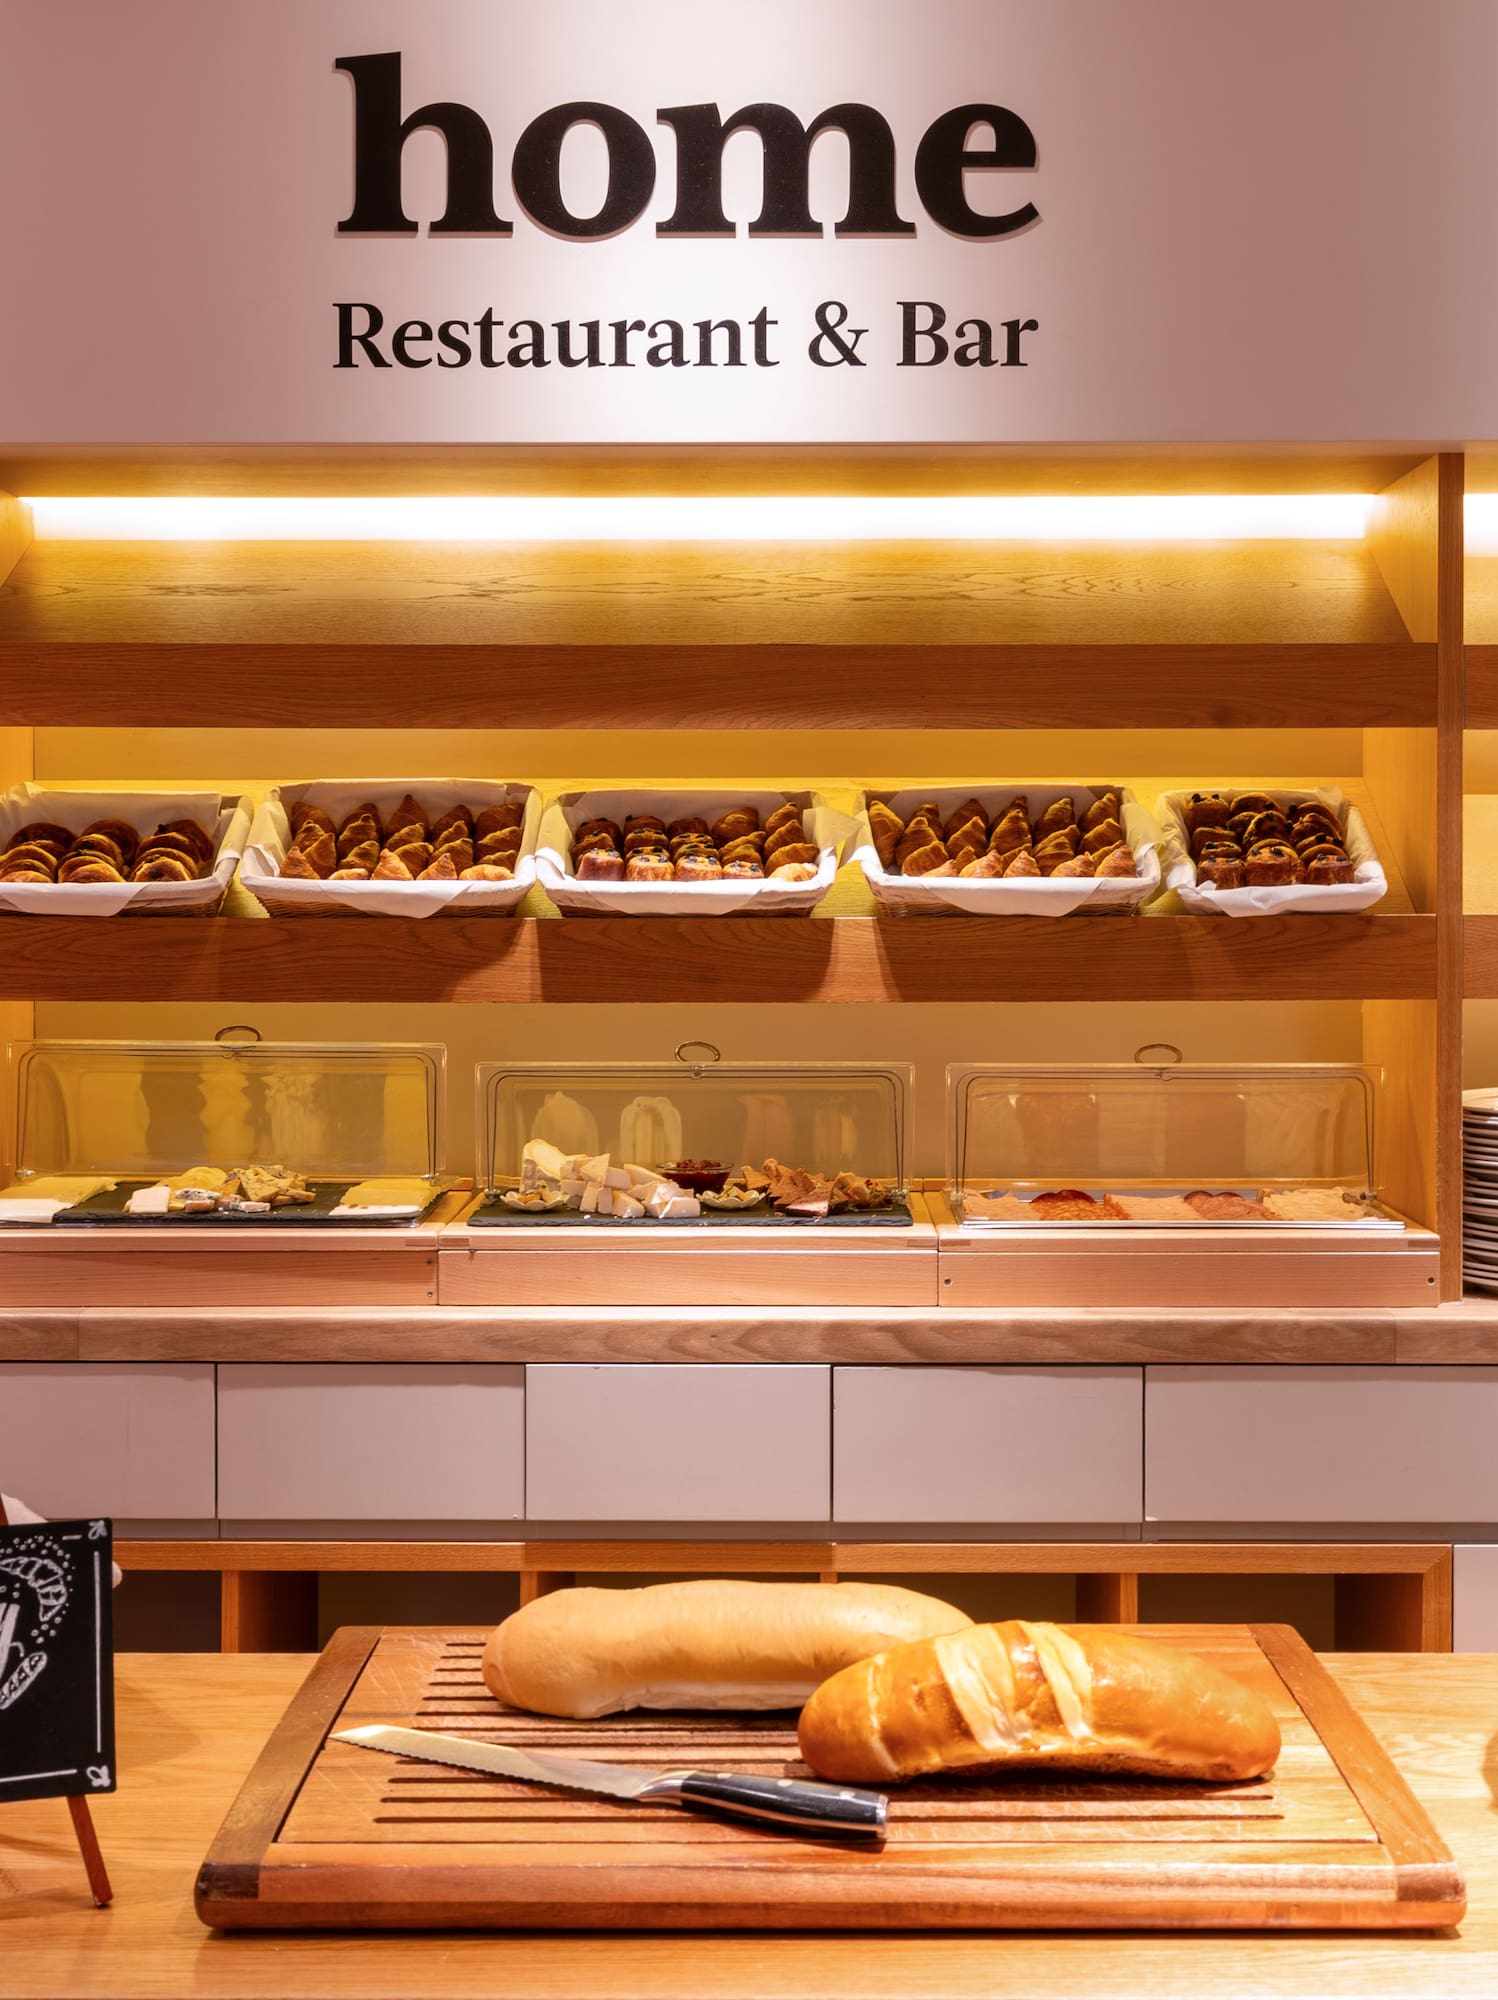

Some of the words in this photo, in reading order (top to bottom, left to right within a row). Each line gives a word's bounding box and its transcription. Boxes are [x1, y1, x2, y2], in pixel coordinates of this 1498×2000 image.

[334, 51, 1041, 238] home
[332, 302, 780, 369] Restaurant
[808, 301, 869, 367] &
[896, 301, 1039, 367] Bar
